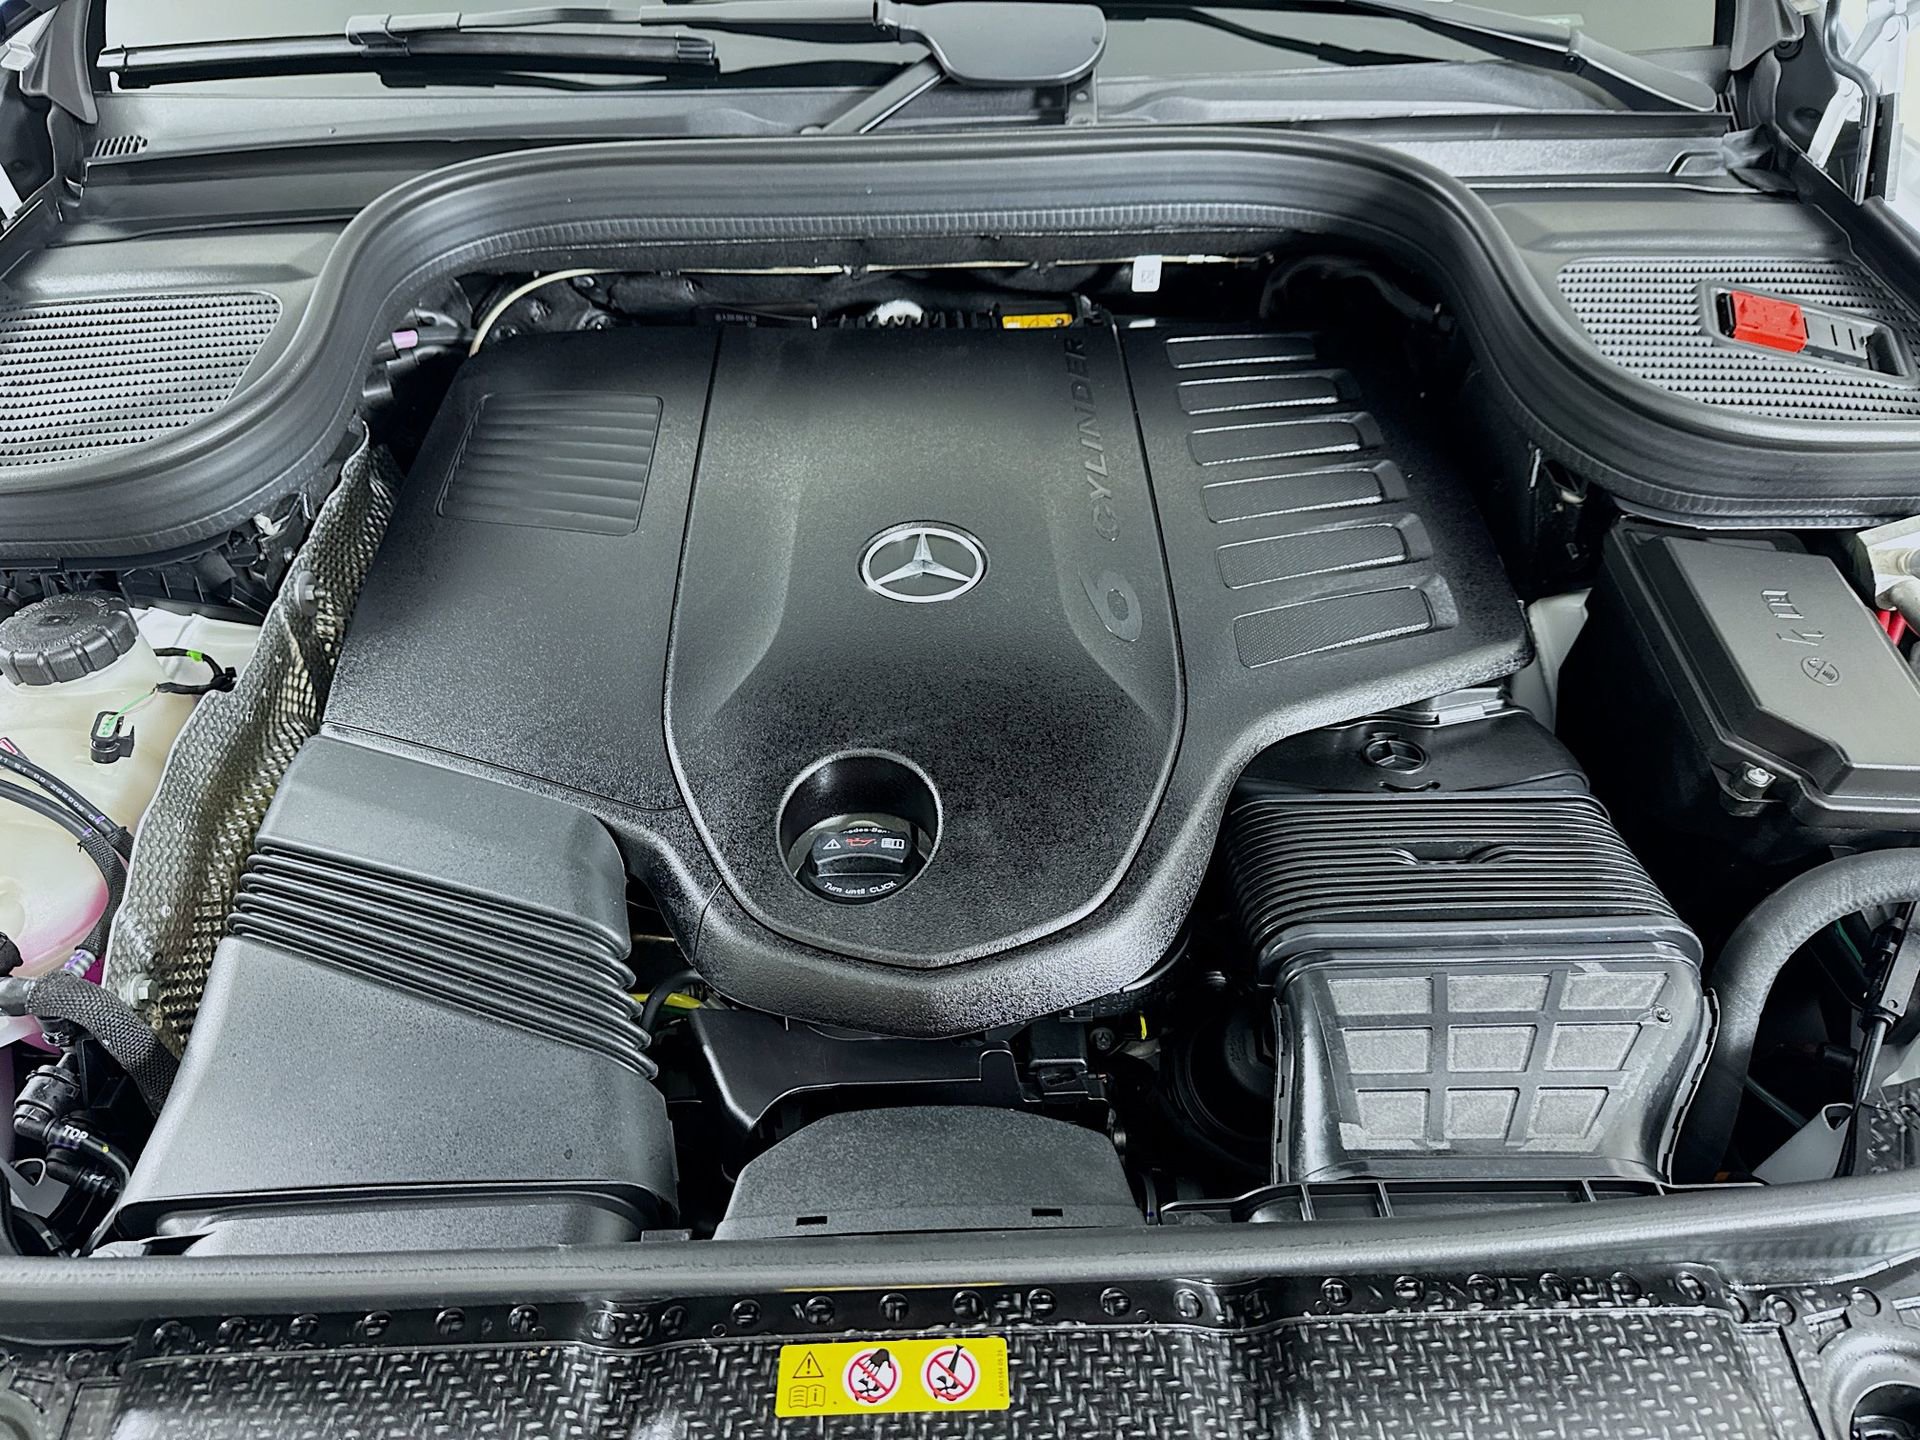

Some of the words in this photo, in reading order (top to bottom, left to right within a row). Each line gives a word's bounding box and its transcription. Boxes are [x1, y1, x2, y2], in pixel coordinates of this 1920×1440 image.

[1064, 336, 1120, 542] CYLINDER
[1077, 562, 1143, 642] 6
[824, 881, 842, 893] Turn
[869, 880, 897, 894] CLICK
[62, 1124, 89, 1142] TOP
